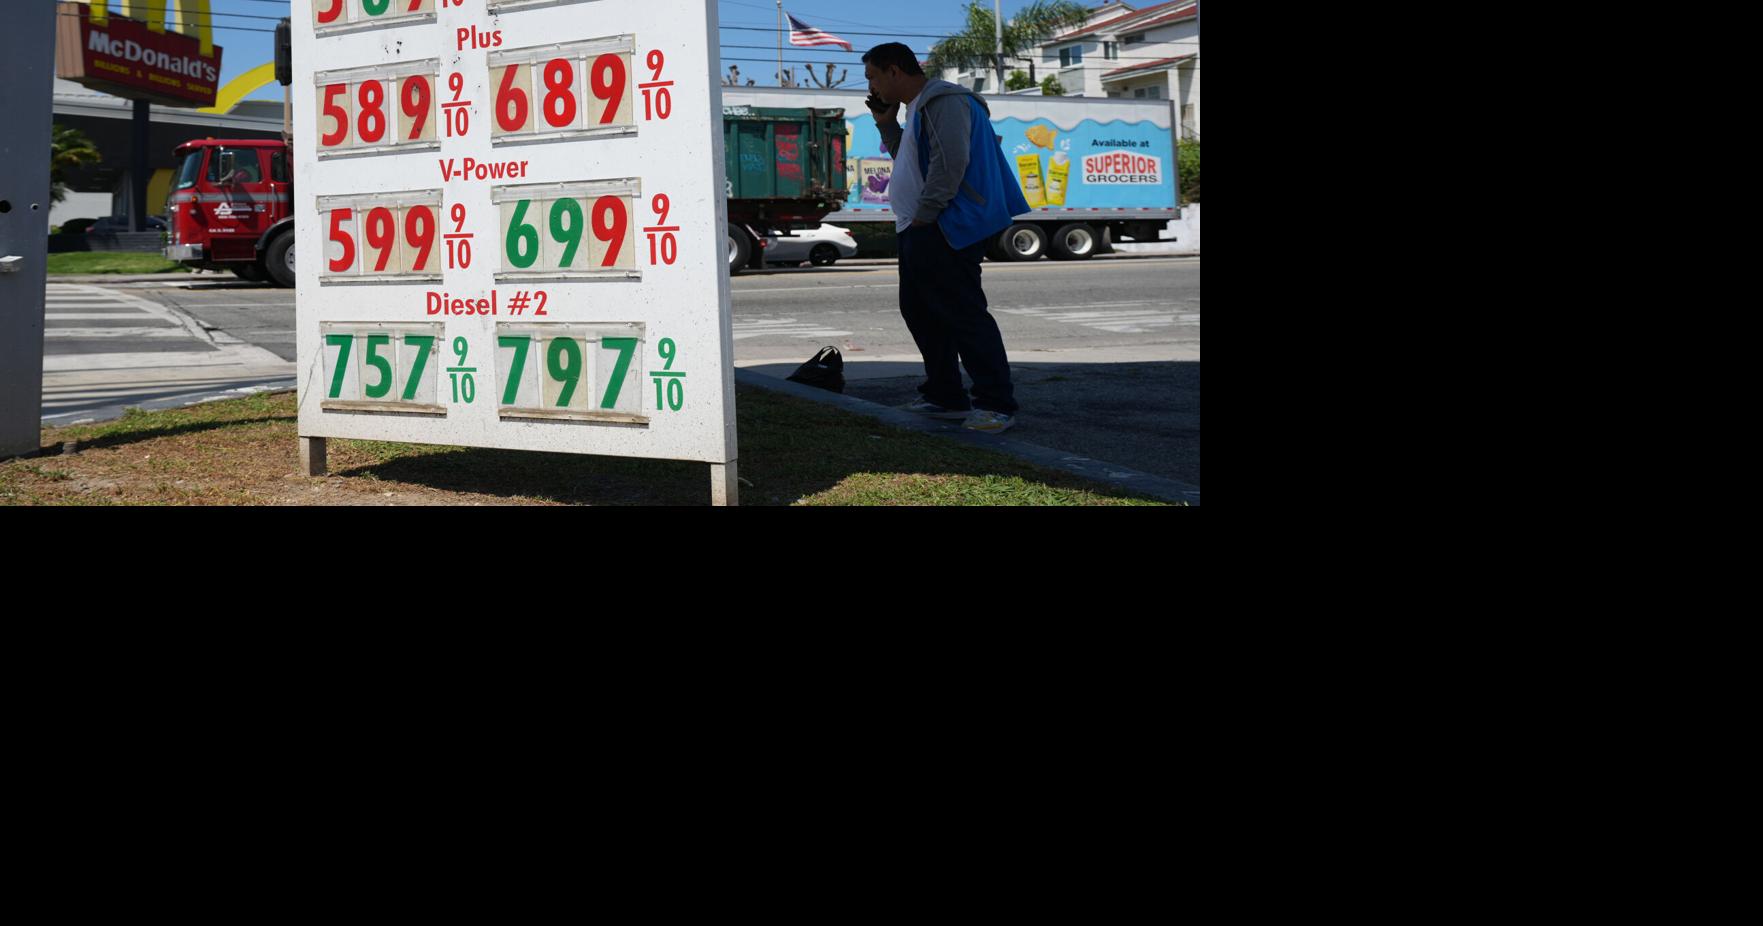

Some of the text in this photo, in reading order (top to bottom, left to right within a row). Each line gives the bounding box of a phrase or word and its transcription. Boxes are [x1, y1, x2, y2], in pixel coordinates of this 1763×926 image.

[88, 30, 216, 82] McDonald's
[457, 25, 503, 51] Plus
[322, 75, 431, 146] 589
[495, 54, 627, 132] 689
[1086, 153, 1157, 174] SUPERIOR
[1091, 139, 1150, 148] Available at
[440, 158, 529, 182] V-Power
[1086, 174, 1158, 183] GROCERS
[329, 205, 436, 272] 599
[505, 194, 628, 268] 699
[426, 290, 548, 316] Diesel #2
[326, 334, 435, 399] 757
[498, 336, 638, 408] 797
